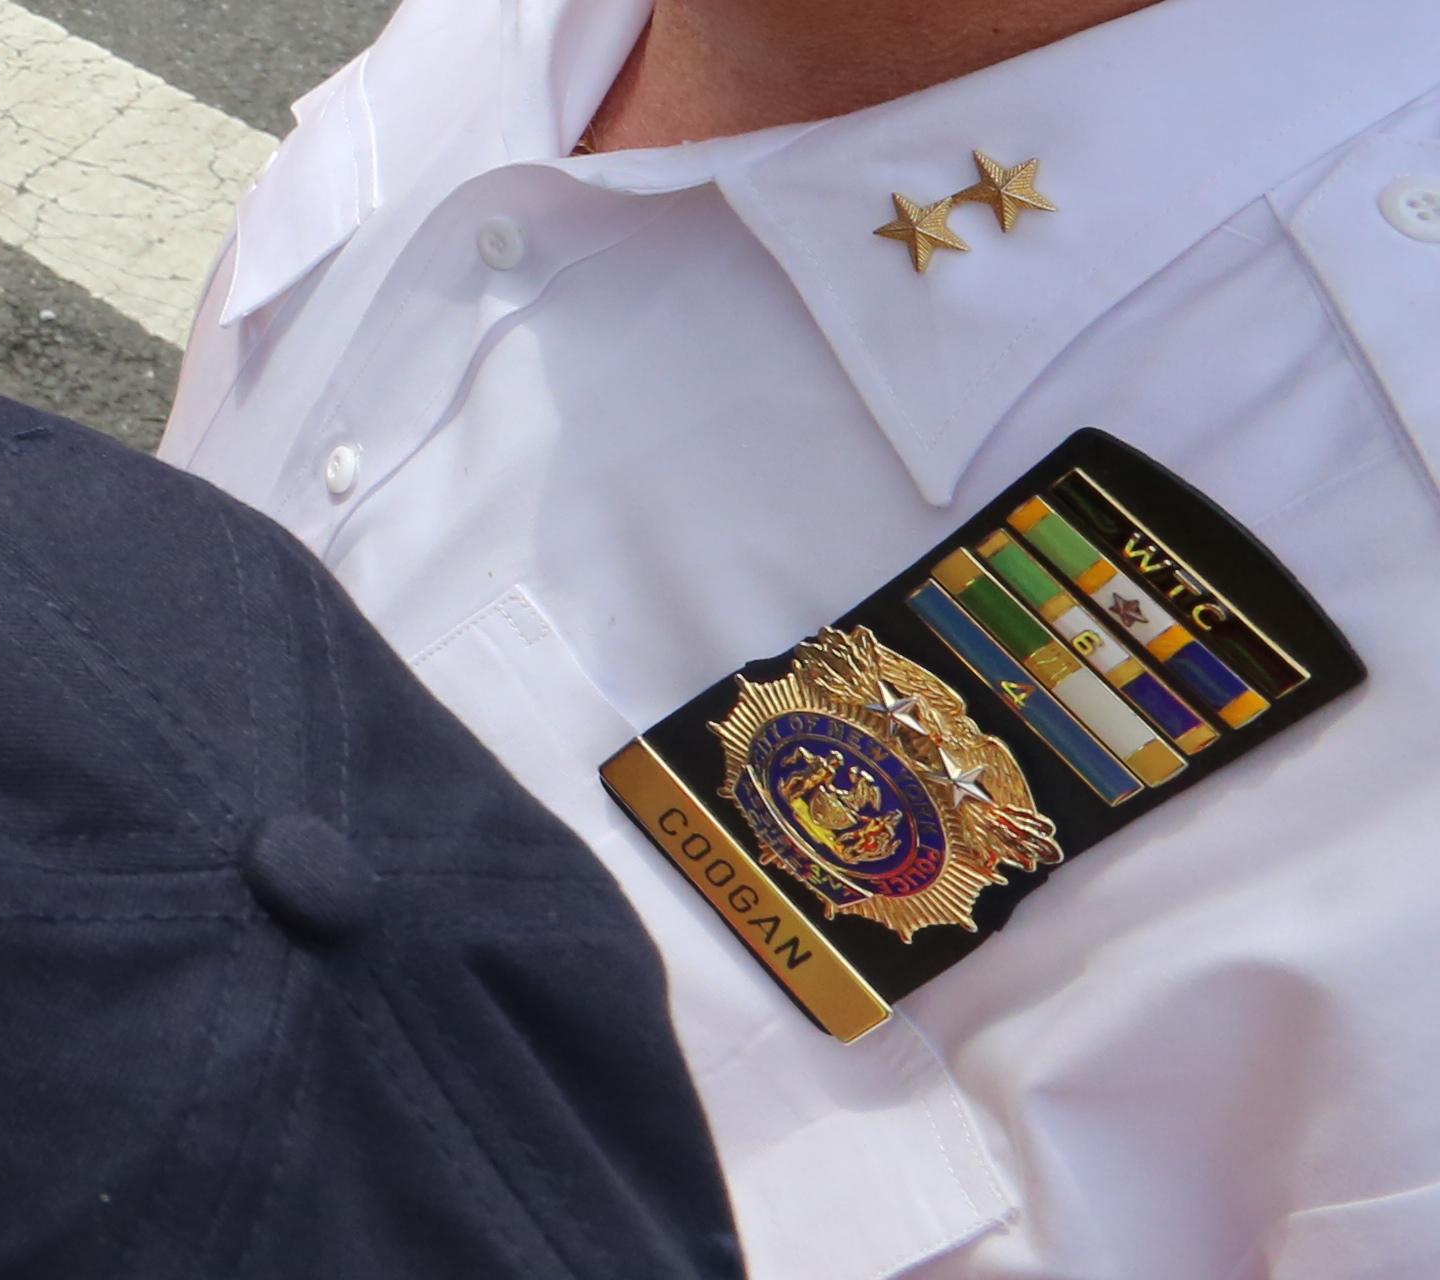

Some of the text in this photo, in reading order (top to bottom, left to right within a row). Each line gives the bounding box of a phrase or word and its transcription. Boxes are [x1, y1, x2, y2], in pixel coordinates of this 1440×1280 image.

[1122, 532, 1228, 632] WTC
[1071, 628, 1105, 657] 6
[1000, 679, 1036, 710] 4
[789, 715, 820, 734] OF
[827, 720, 891, 763] NEW
[898, 766, 939, 836] YORK
[658, 807, 813, 970] COOGAN
[872, 847, 942, 896] POLICE
